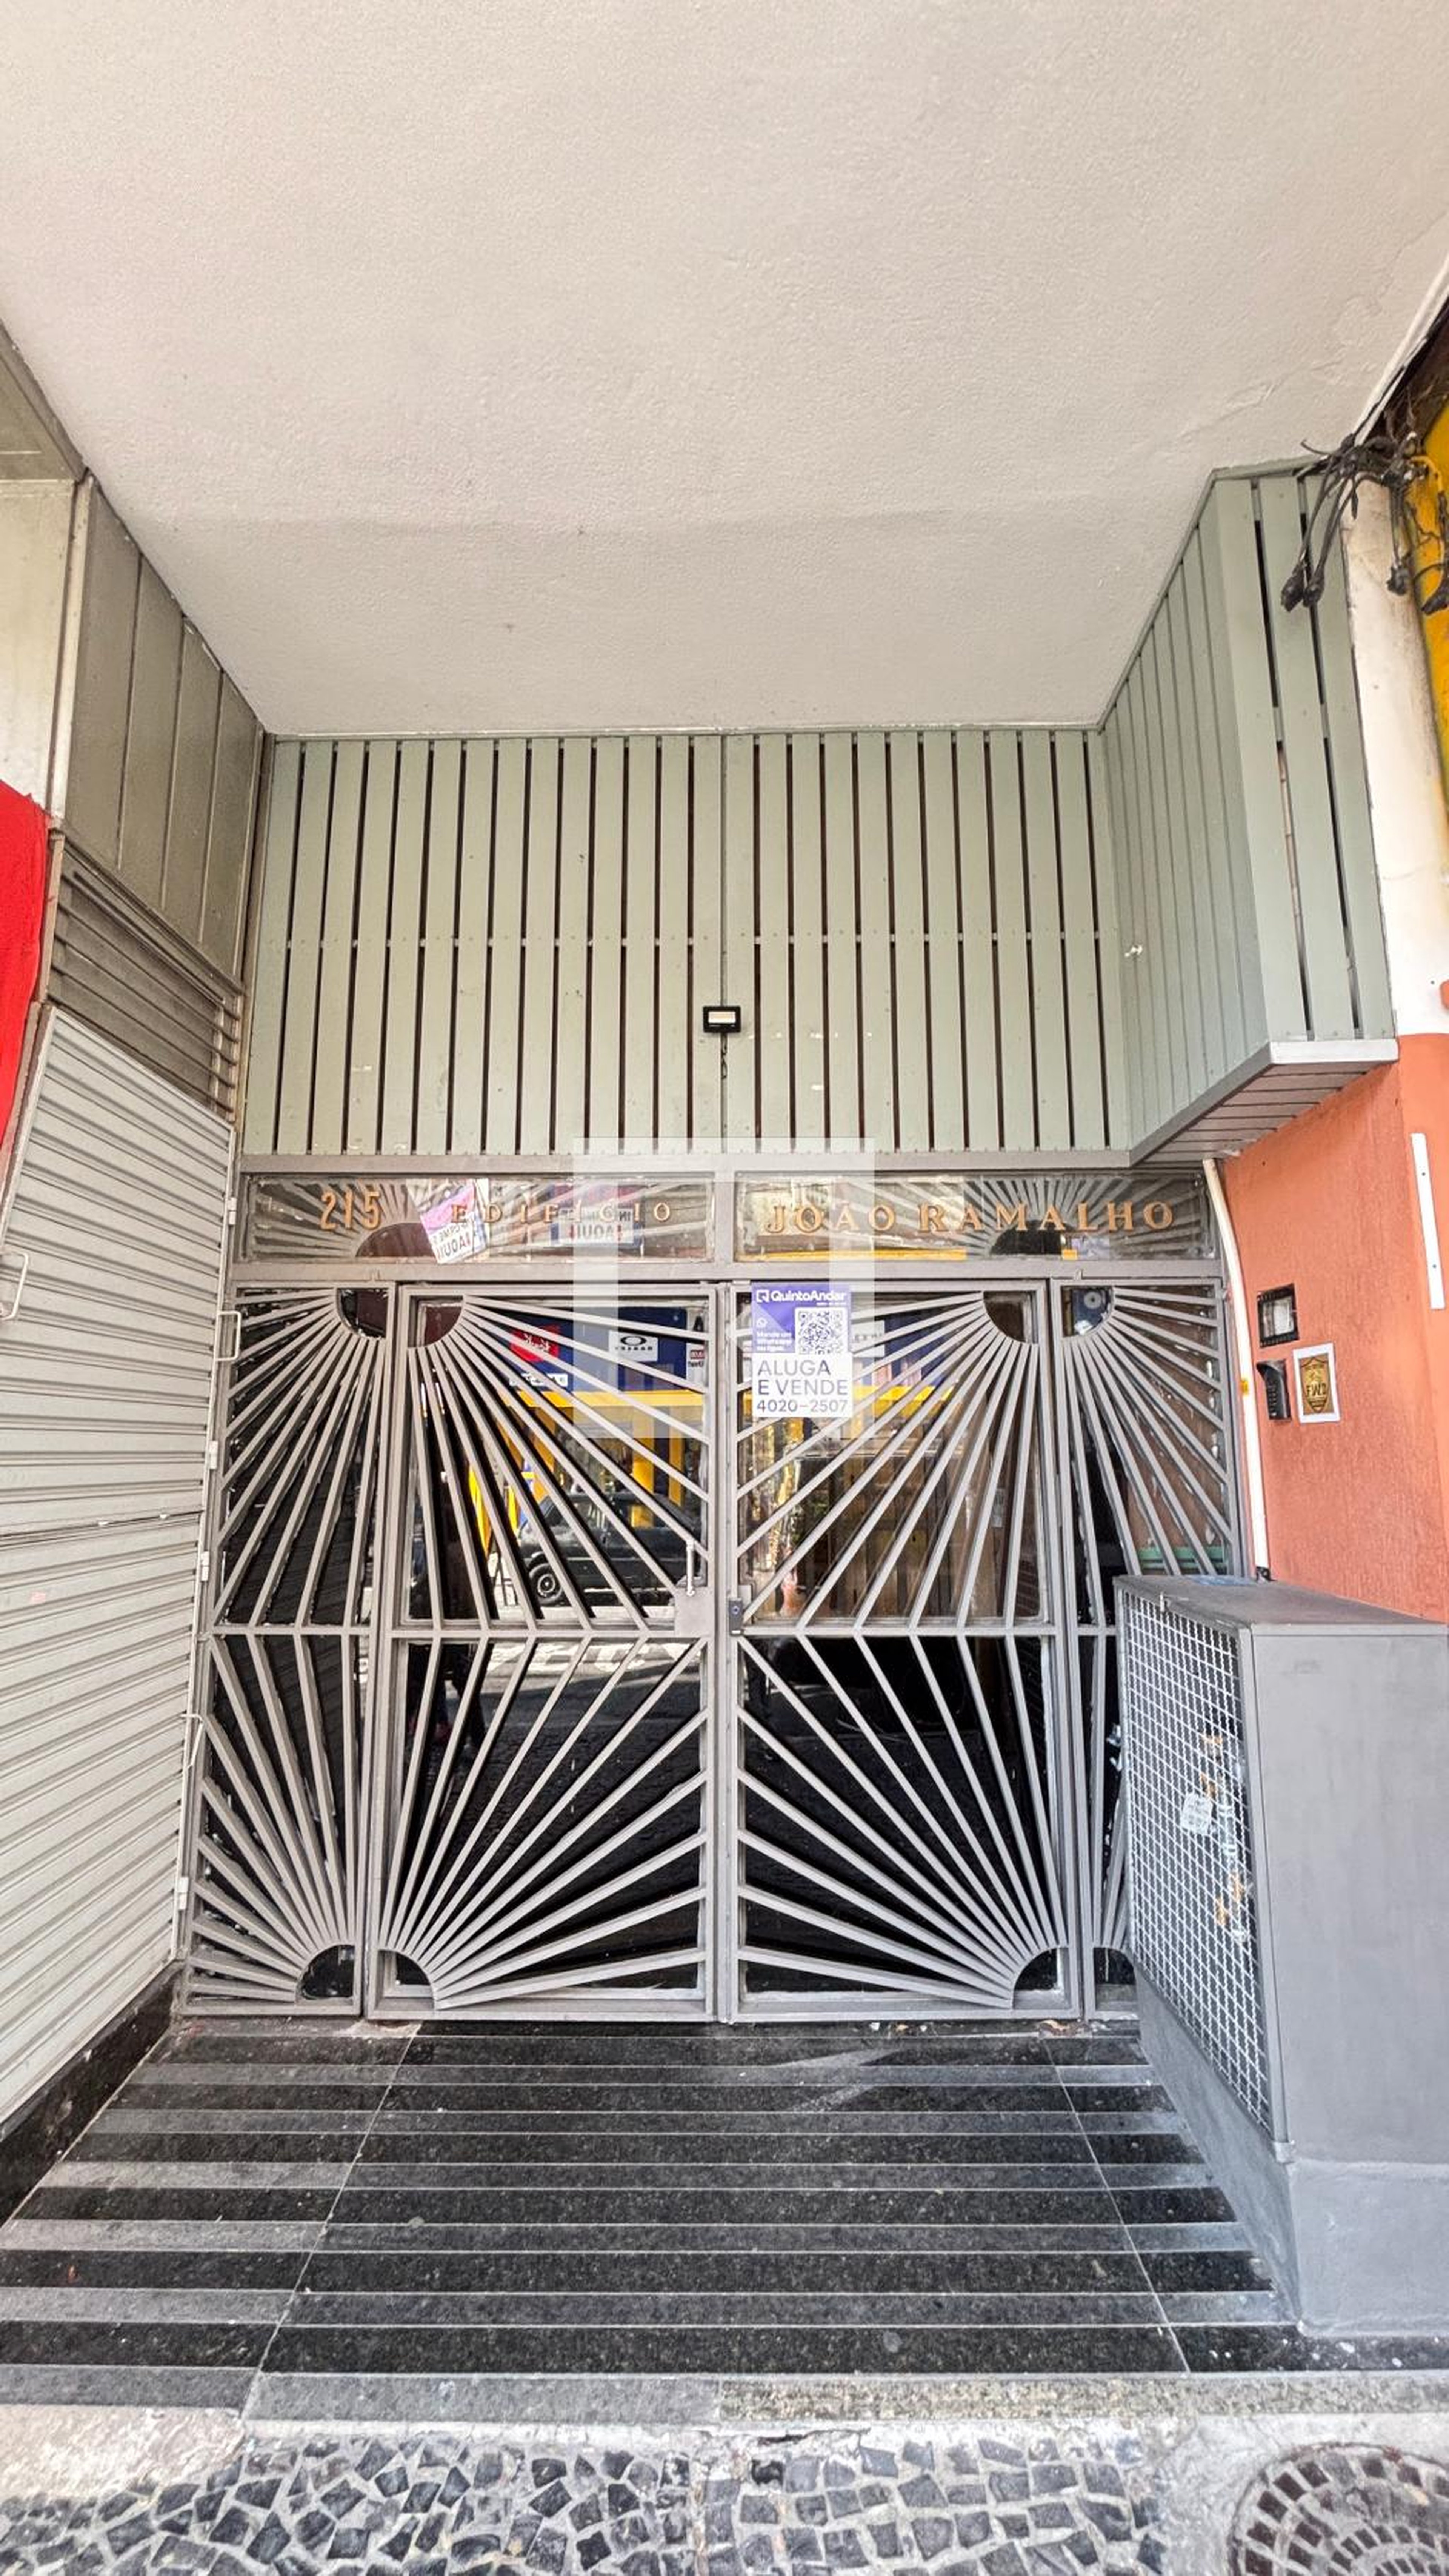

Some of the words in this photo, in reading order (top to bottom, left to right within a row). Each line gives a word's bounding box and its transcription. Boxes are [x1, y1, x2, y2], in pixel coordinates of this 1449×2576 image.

[319, 1190, 381, 1232] 215
[764, 1200, 896, 1233] JOÃO
[918, 1199, 1174, 1232] RAMALHO
[771, 1290, 846, 1301] QuintoAndar
[758, 1360, 831, 1376] ALUGA
[758, 1379, 770, 1395] E
[775, 1379, 848, 1396] VENDE
[757, 1399, 848, 1413] 4020-2507
